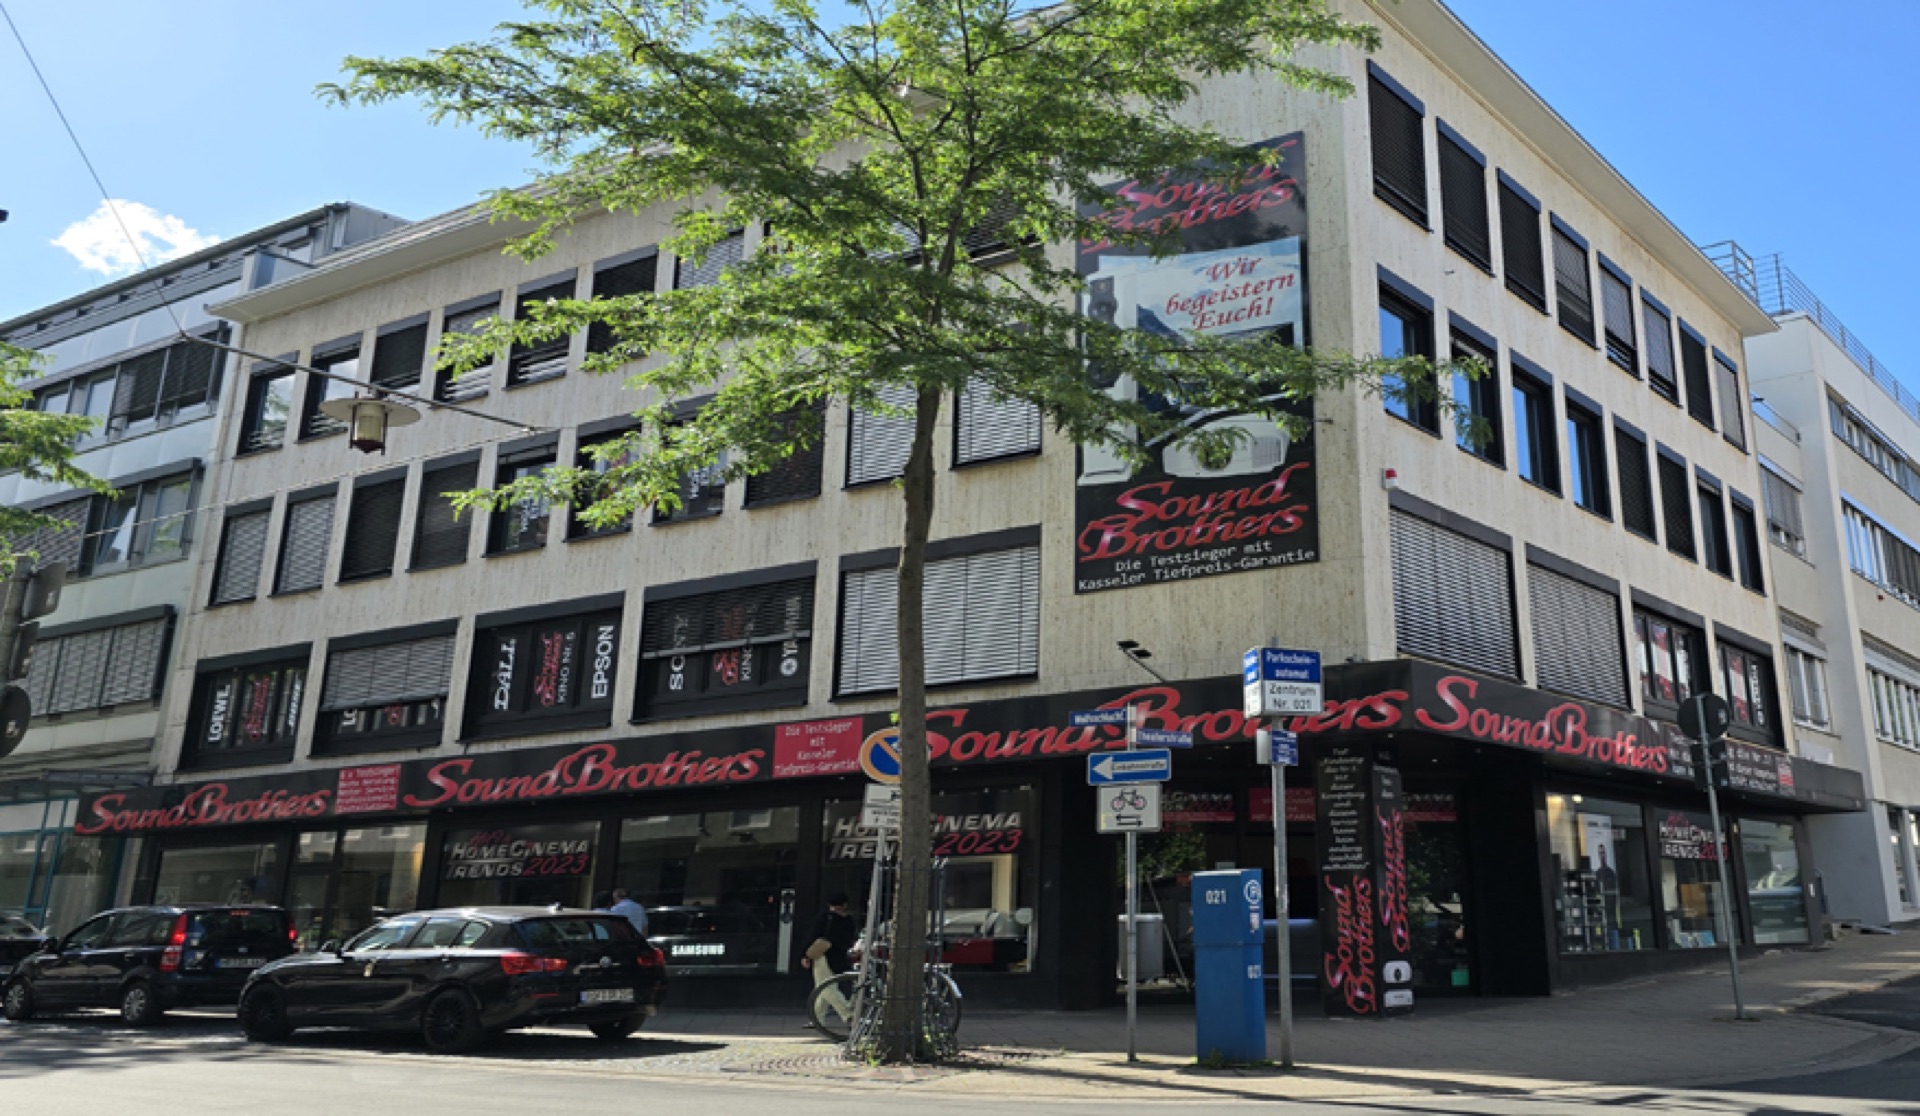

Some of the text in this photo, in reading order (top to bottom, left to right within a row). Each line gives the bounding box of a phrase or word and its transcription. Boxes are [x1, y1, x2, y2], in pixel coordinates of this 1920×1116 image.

[1206, 256, 1262, 282] Wir
[1165, 273, 1295, 317] begeistern
[1193, 297, 1274, 330] Euch!
[1116, 462, 1310, 522] Sound
[1078, 505, 1310, 563] Brothers
[1078, 549, 1315, 590] Kasseler Tiefpreis-Garantie
[1115, 540, 1272, 573] Die Testsieger mit
[591, 625, 614, 699] EPSON
[1266, 650, 1317, 664] Parkschein-
[1275, 669, 1310, 679] automat
[1269, 683, 1316, 696] Zentrum
[1273, 699, 1312, 709] Nr. 021
[1137, 729, 1193, 745] Theaterstraße
[1415, 675, 1554, 749] Sound
[1548, 703, 1669, 773] Brothers
[402, 744, 765, 806] Sound Brothers
[75, 783, 332, 834] Sound Brothers
[934, 829, 1023, 855] 2023
[523, 855, 589, 876] 2023
[1376, 804, 1395, 926] Sound
[1390, 807, 1410, 952] Brothers
[1205, 889, 1227, 904] 021
[1324, 874, 1353, 988] Sound
[1344, 874, 1377, 1014] Brothers
[671, 943, 726, 957] SAMSUNG
